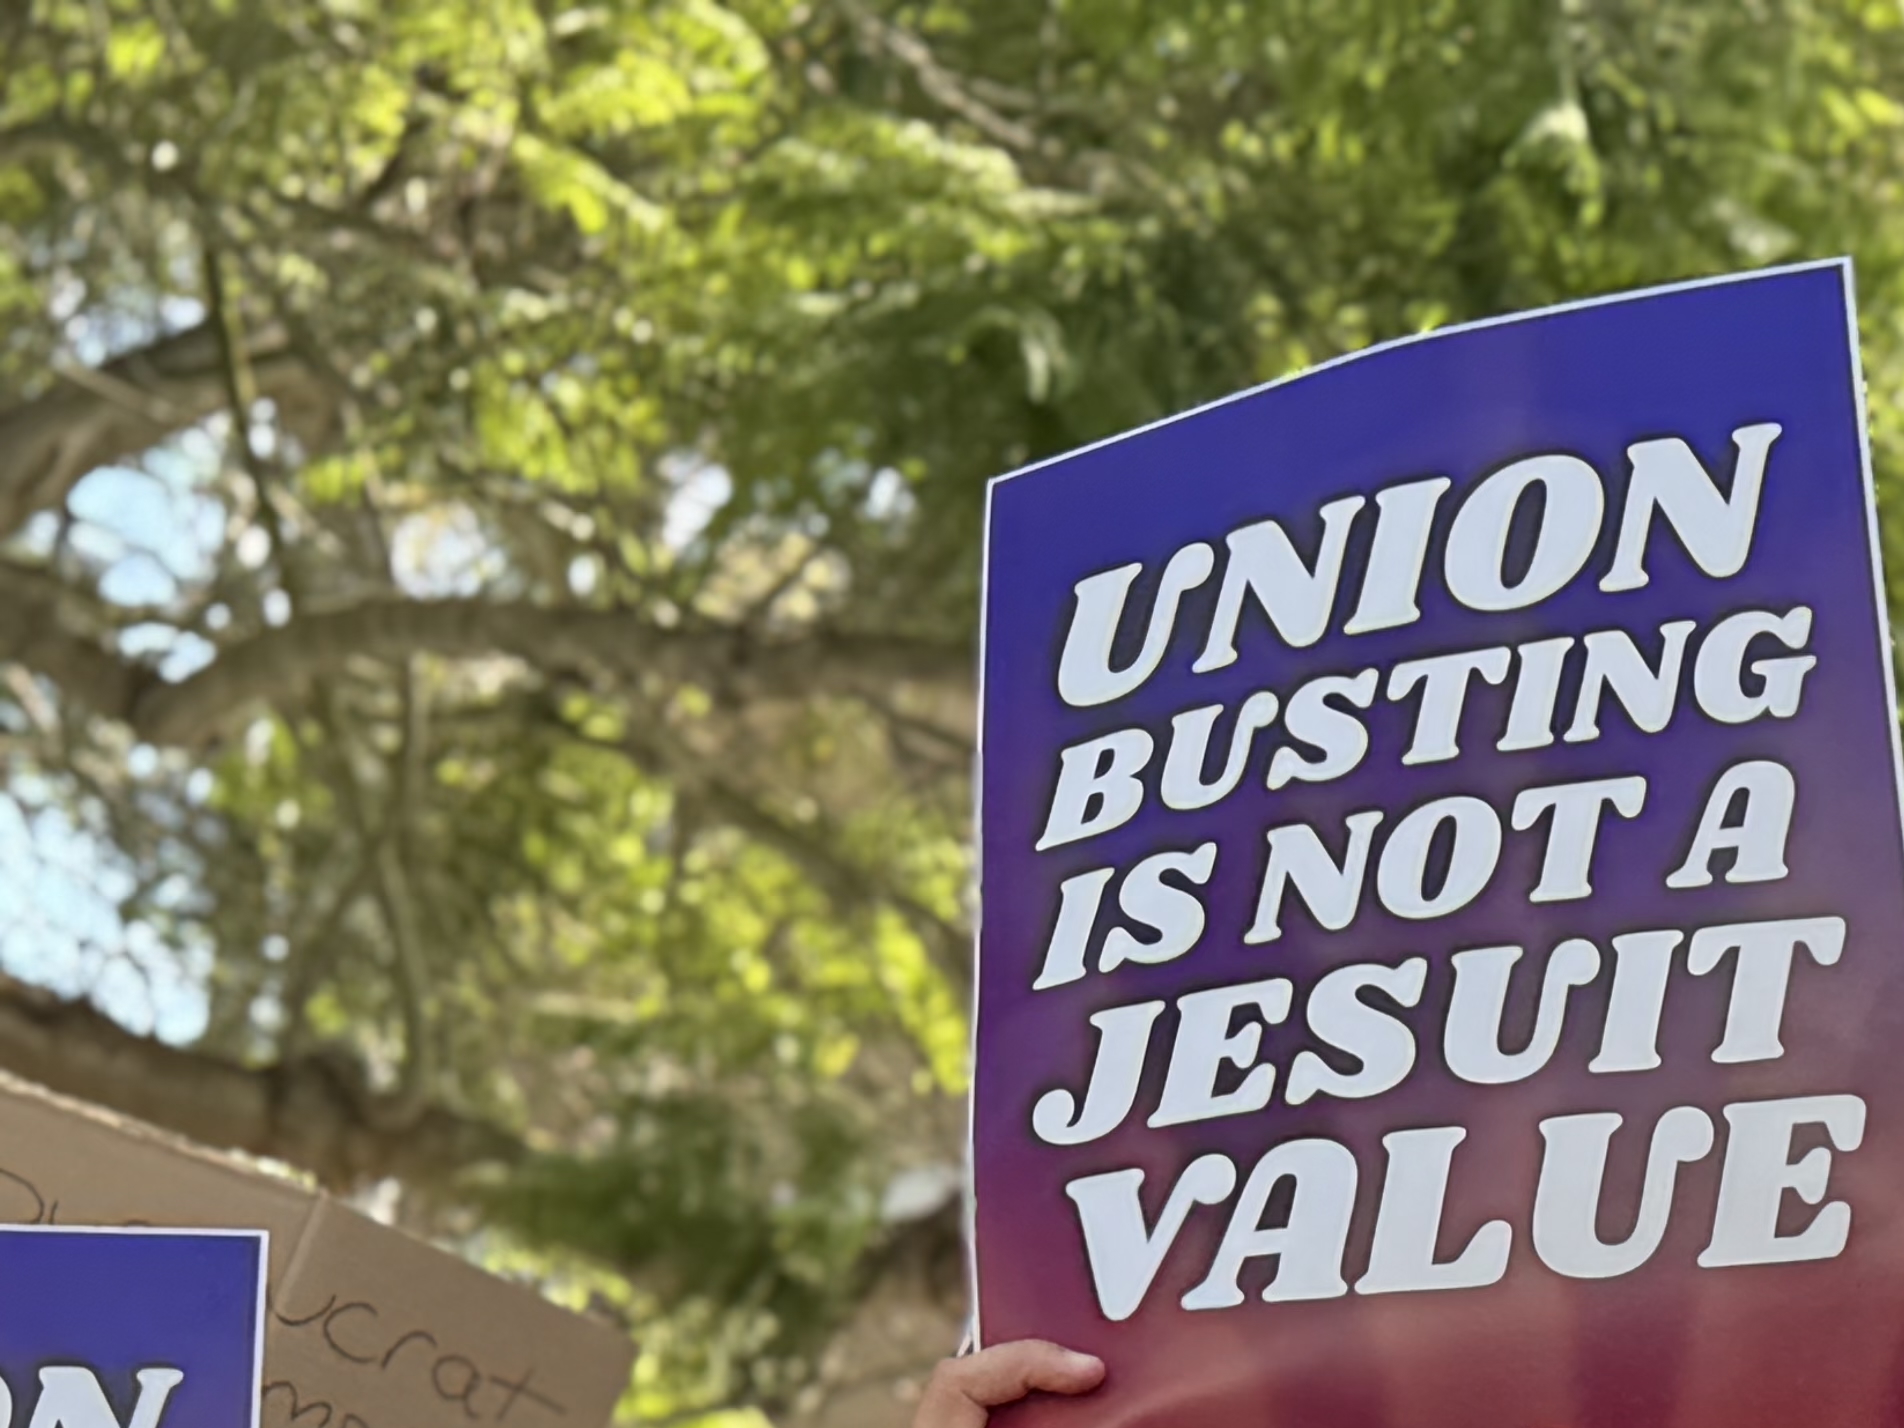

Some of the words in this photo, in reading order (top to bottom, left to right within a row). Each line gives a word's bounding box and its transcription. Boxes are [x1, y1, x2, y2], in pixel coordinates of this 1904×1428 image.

[1056, 422, 1782, 705] UNION
[1035, 606, 1816, 851] BUSTING
[1032, 842, 1217, 990] IS
[1244, 776, 1646, 943] NOT
[1666, 760, 1795, 888] A
[1031, 916, 1846, 1144] JESUIT
[1066, 1094, 1866, 1321] VALUE
